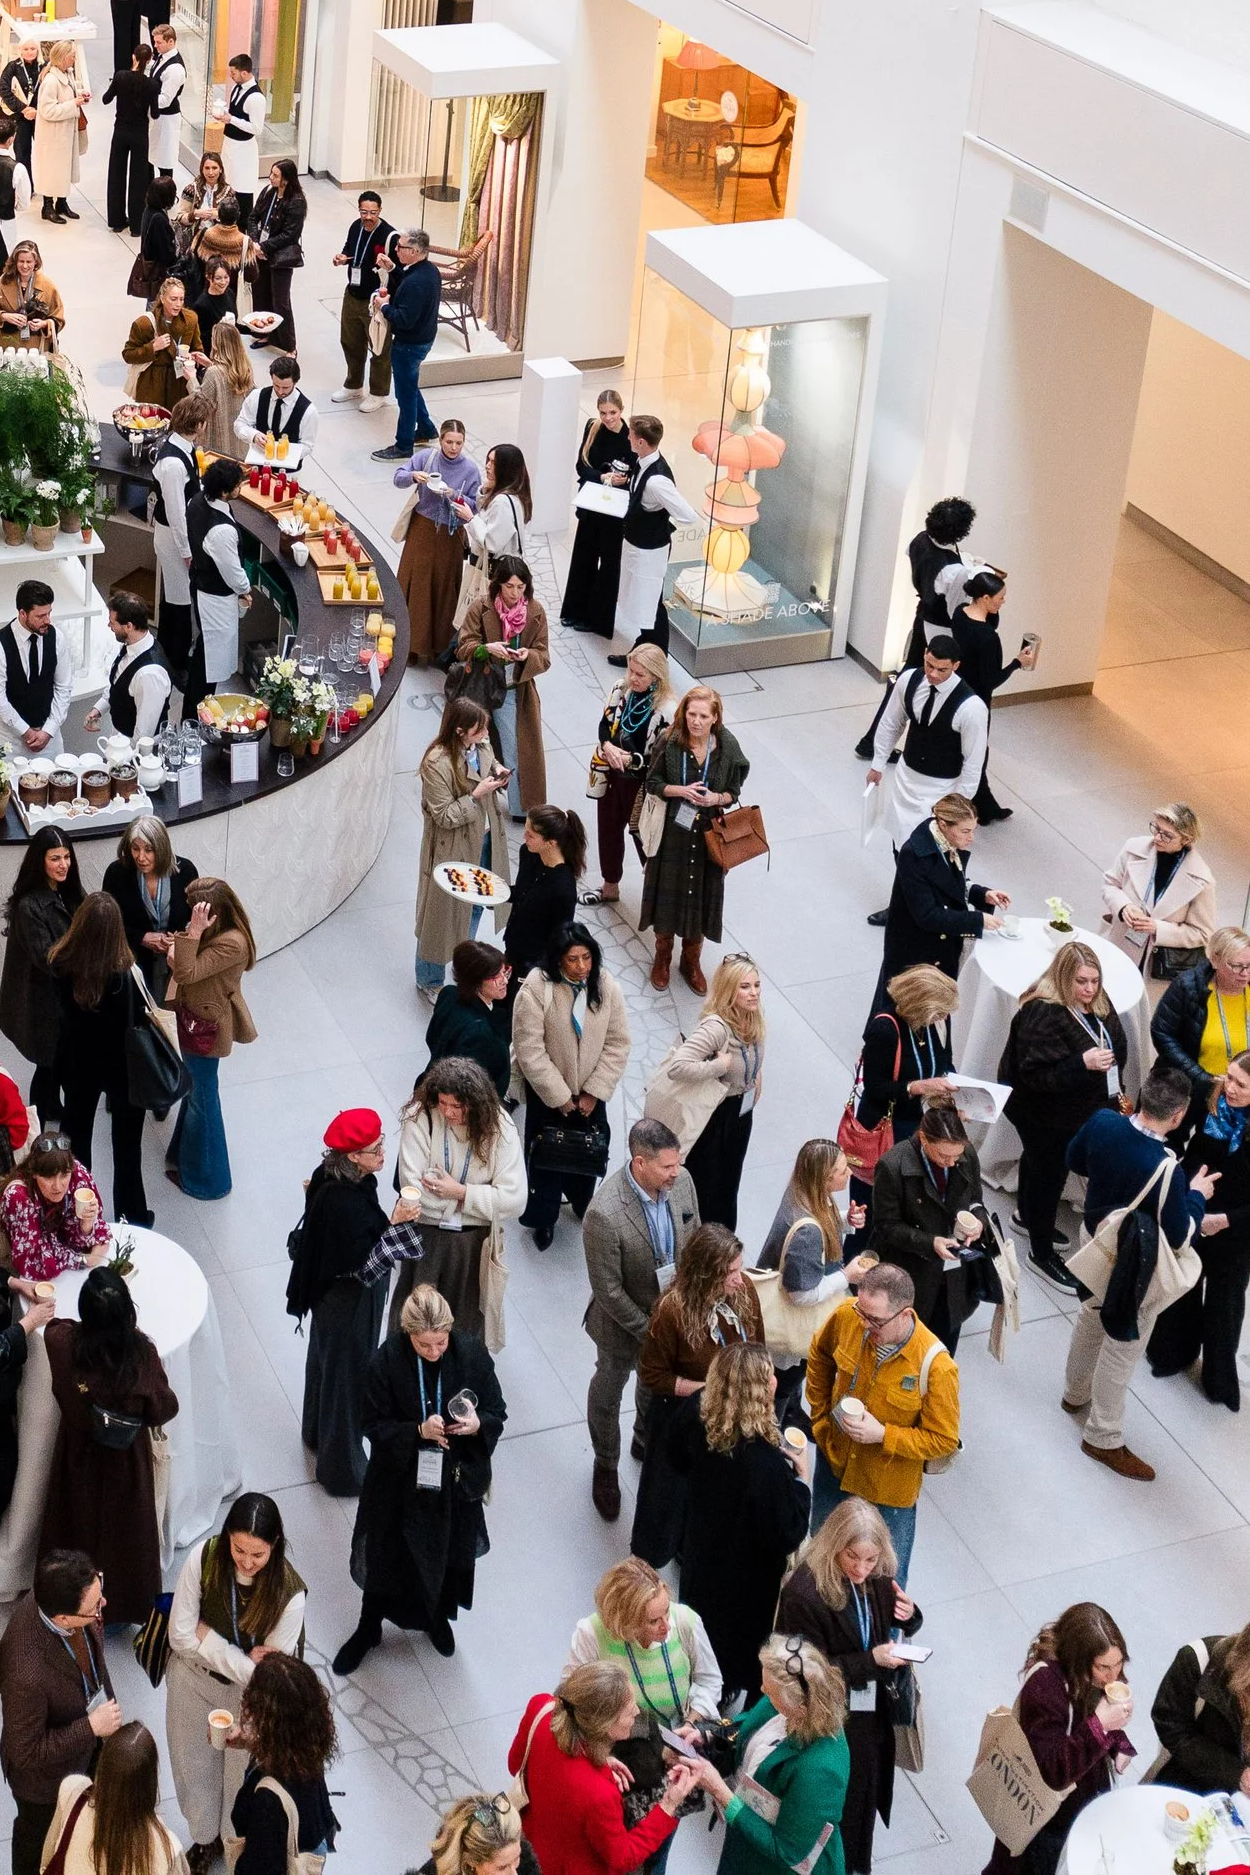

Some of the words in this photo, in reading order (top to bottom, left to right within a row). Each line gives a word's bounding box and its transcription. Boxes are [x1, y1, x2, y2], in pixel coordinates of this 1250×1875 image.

[705, 615, 720, 627] A
[722, 606, 774, 625] SHADE
[777, 598, 832, 619] ABOVE
[990, 1752, 1036, 1826] ONDON
